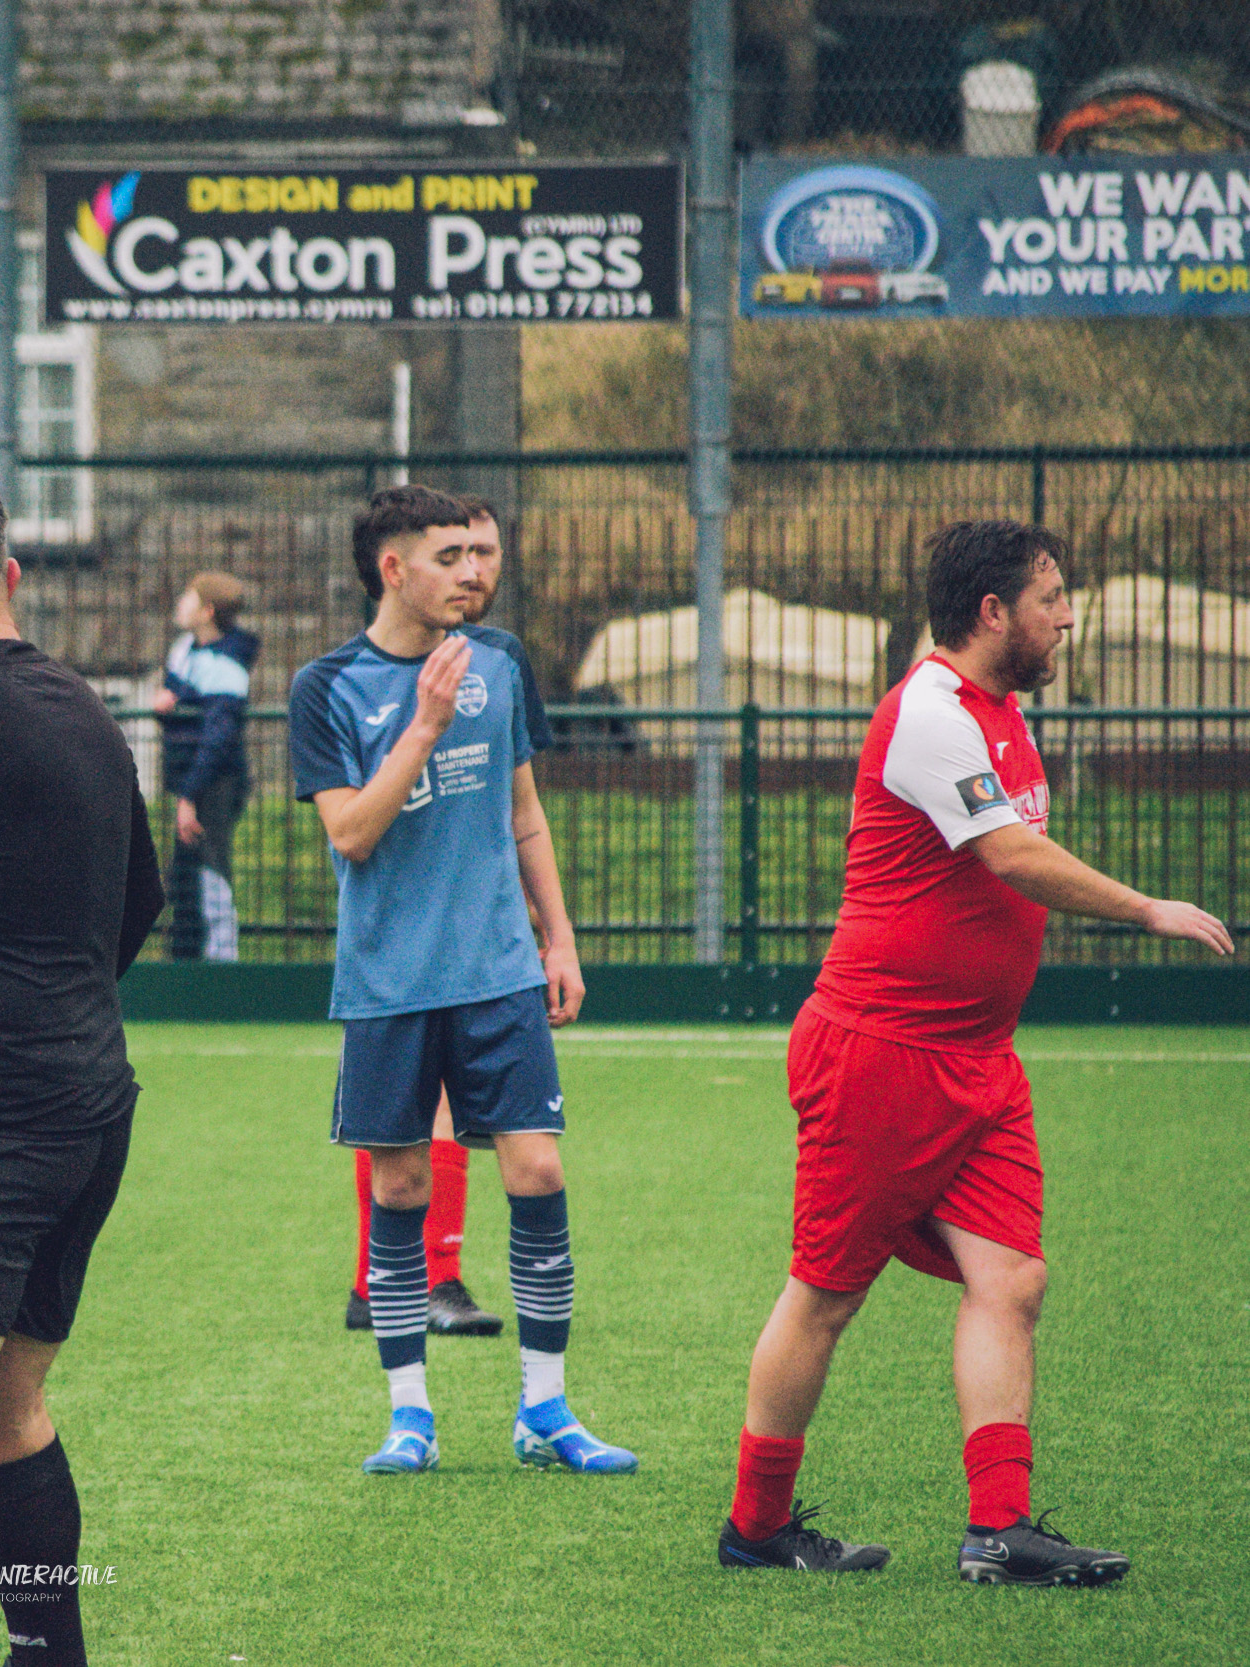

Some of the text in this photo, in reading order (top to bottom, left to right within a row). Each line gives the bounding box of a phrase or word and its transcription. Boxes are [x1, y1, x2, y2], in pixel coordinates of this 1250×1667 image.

[188, 175, 538, 213] DESIGN and PRINT
[1039, 172, 1250, 217] WE WAN
[112, 215, 643, 294] Caxton Press
[978, 219, 1129, 264] YOUR
[981, 268, 1052, 295] AND
[1058, 268, 1108, 294] WE
[1115, 267, 1173, 294] PAY
[62, 297, 395, 324] www.caxtonpress.cymru
[411, 292, 462, 318] tel:
[465, 291, 550, 319] 01443
